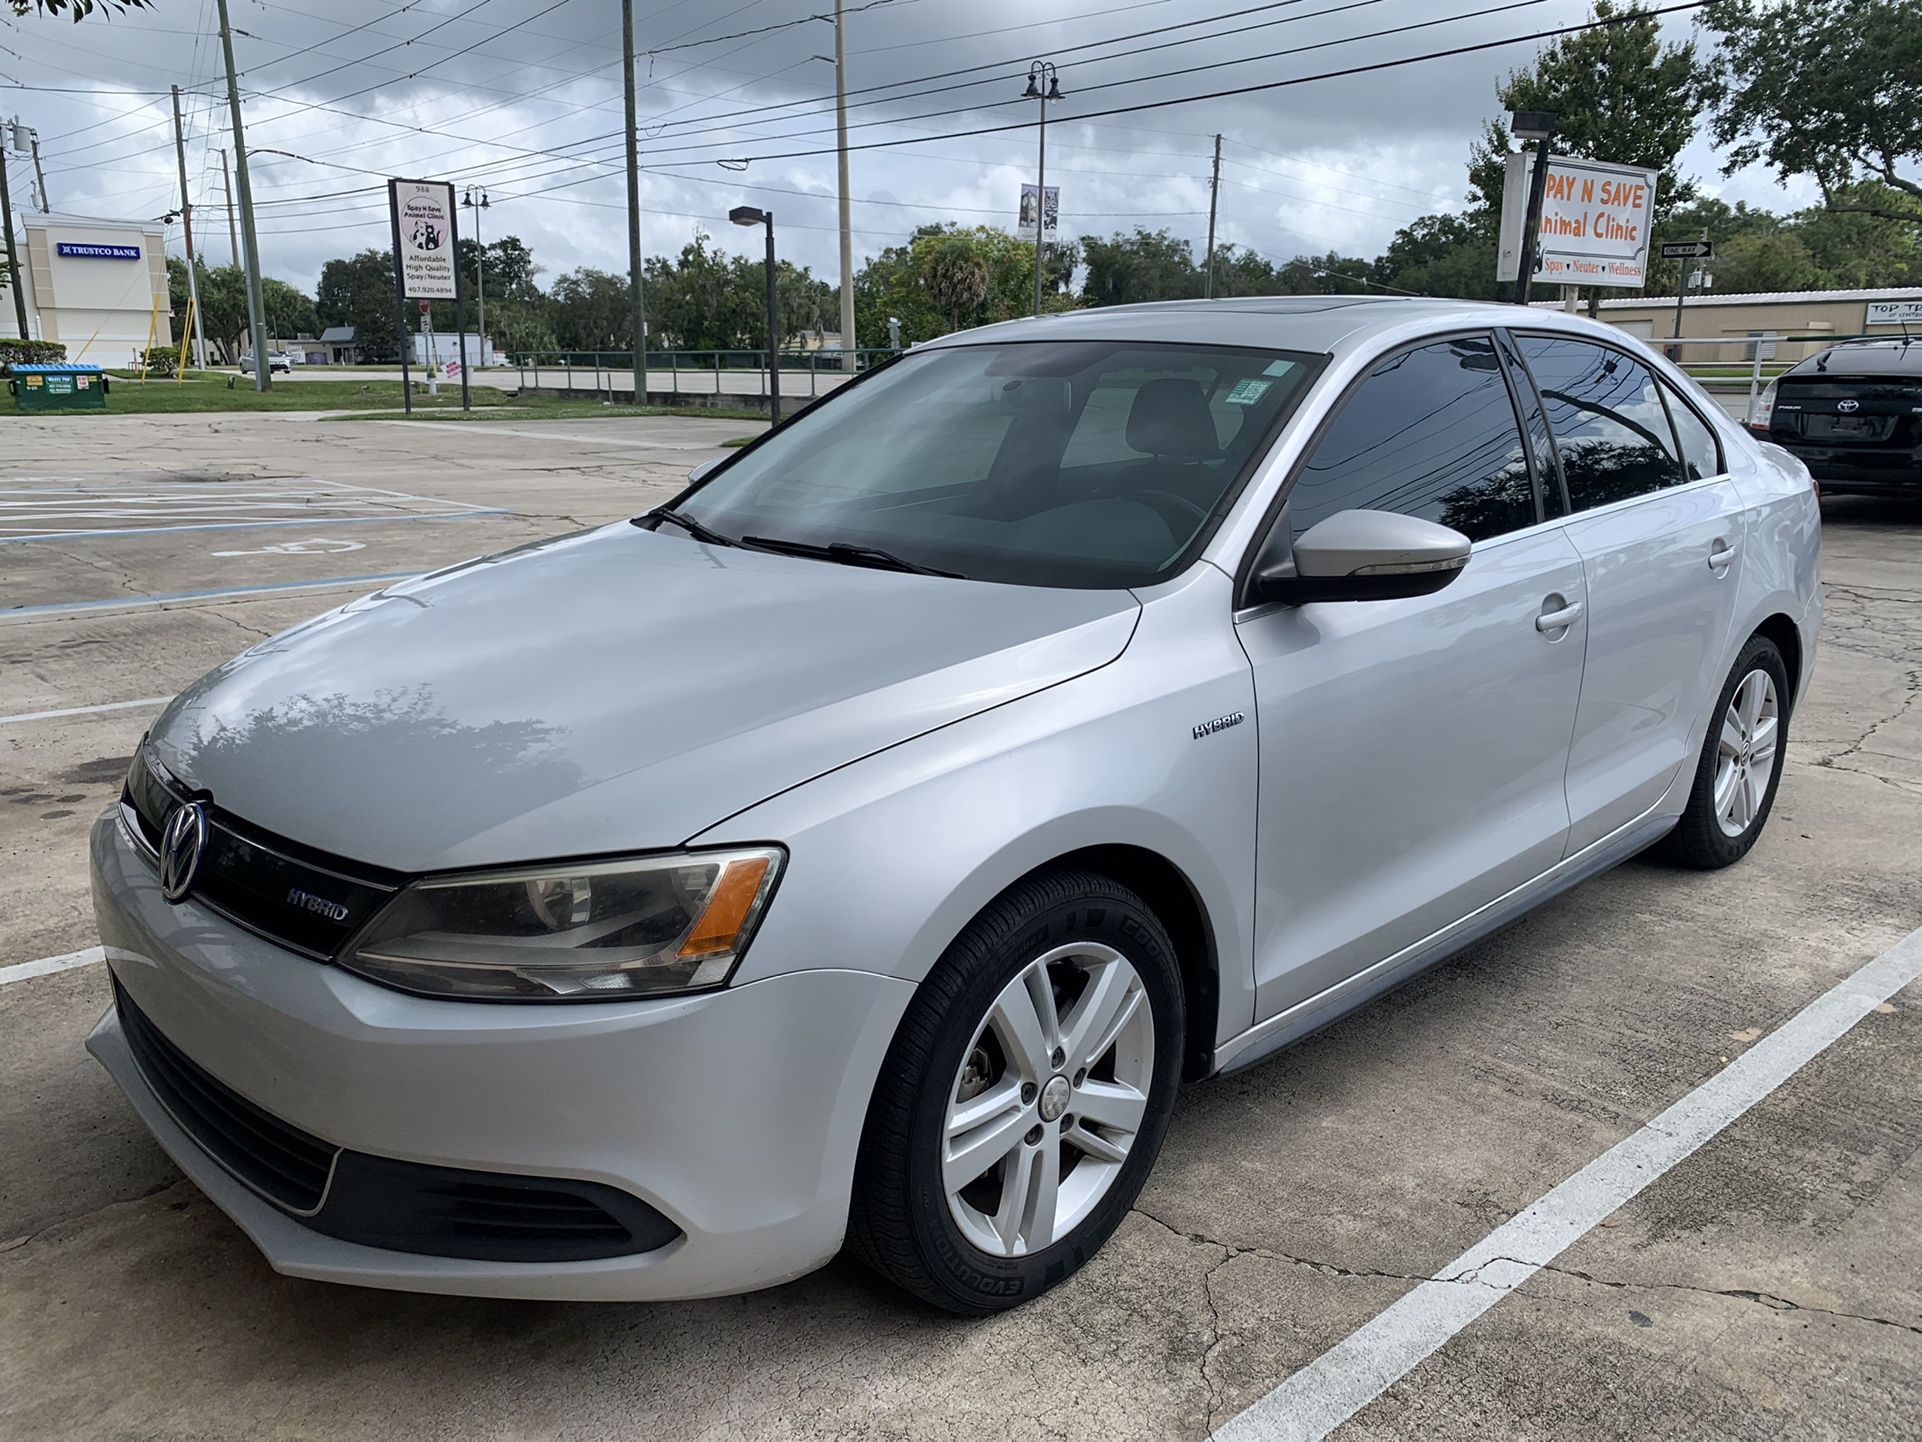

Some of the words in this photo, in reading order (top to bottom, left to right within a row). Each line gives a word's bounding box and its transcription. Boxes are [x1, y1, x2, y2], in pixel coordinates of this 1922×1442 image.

[1546, 174, 1577, 201] PAY
[1581, 179, 1595, 203] N
[1600, 181, 1645, 208] SAVE
[1594, 212, 1637, 241] Clinic
[71, 246, 111, 255] TRUSTCO
[113, 248, 137, 257] BANK
[409, 255, 446, 263] Affordable
[406, 264, 424, 272] High
[425, 264, 450, 273] Quality
[1545, 258, 1563, 275] Spay
[1572, 260, 1600, 274] Neuter
[1608, 262, 1642, 277] Wellness
[1870, 304, 1899, 312] TOP
[1192, 711, 1245, 740] HYBRID
[286, 887, 349, 920] HYBRID
